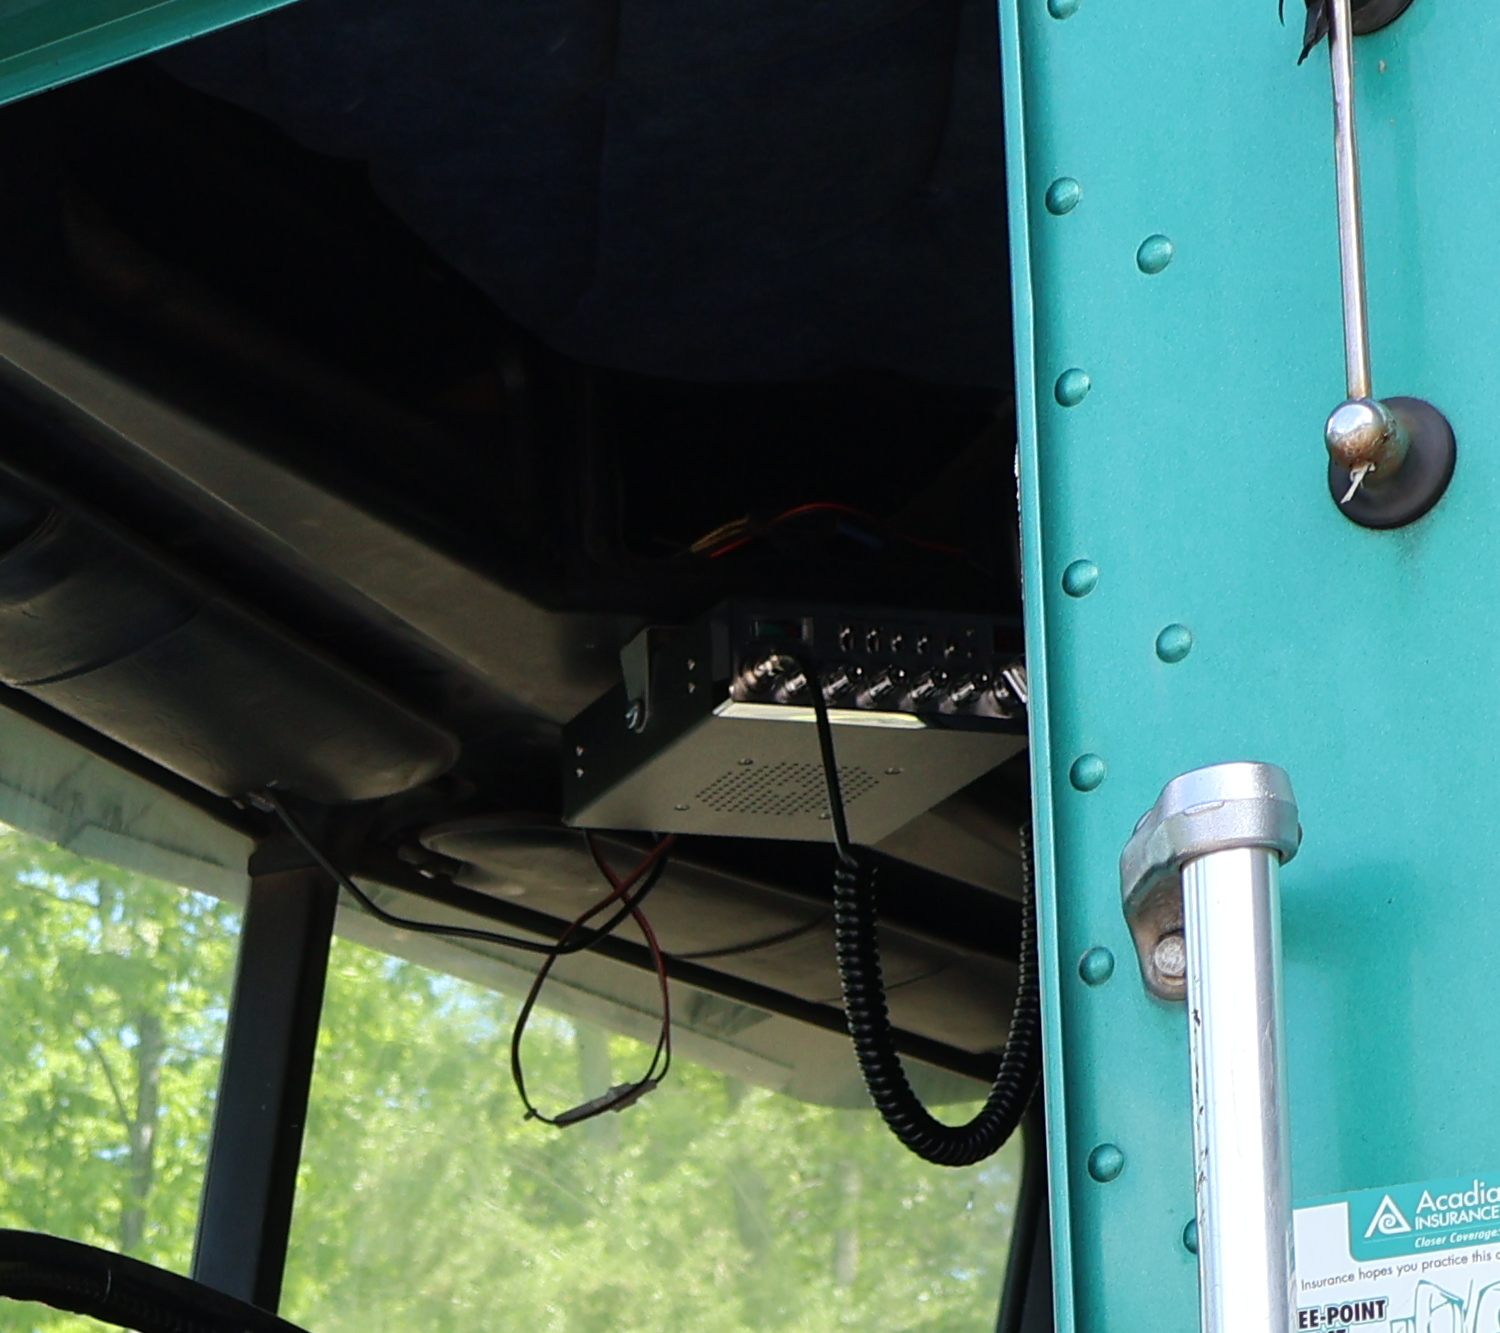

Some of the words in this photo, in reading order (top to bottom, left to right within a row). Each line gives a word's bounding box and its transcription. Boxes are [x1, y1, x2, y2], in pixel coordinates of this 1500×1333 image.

[1414, 1204, 1500, 1231] INSURANCE
[1414, 1235, 1447, 1249] Closer
[1300, 1271, 1355, 1292] Insurance
[1357, 1264, 1394, 1283] hopes
[1396, 1261, 1418, 1277] you
[1421, 1253, 1469, 1273] practice
[1471, 1248, 1492, 1263] this
